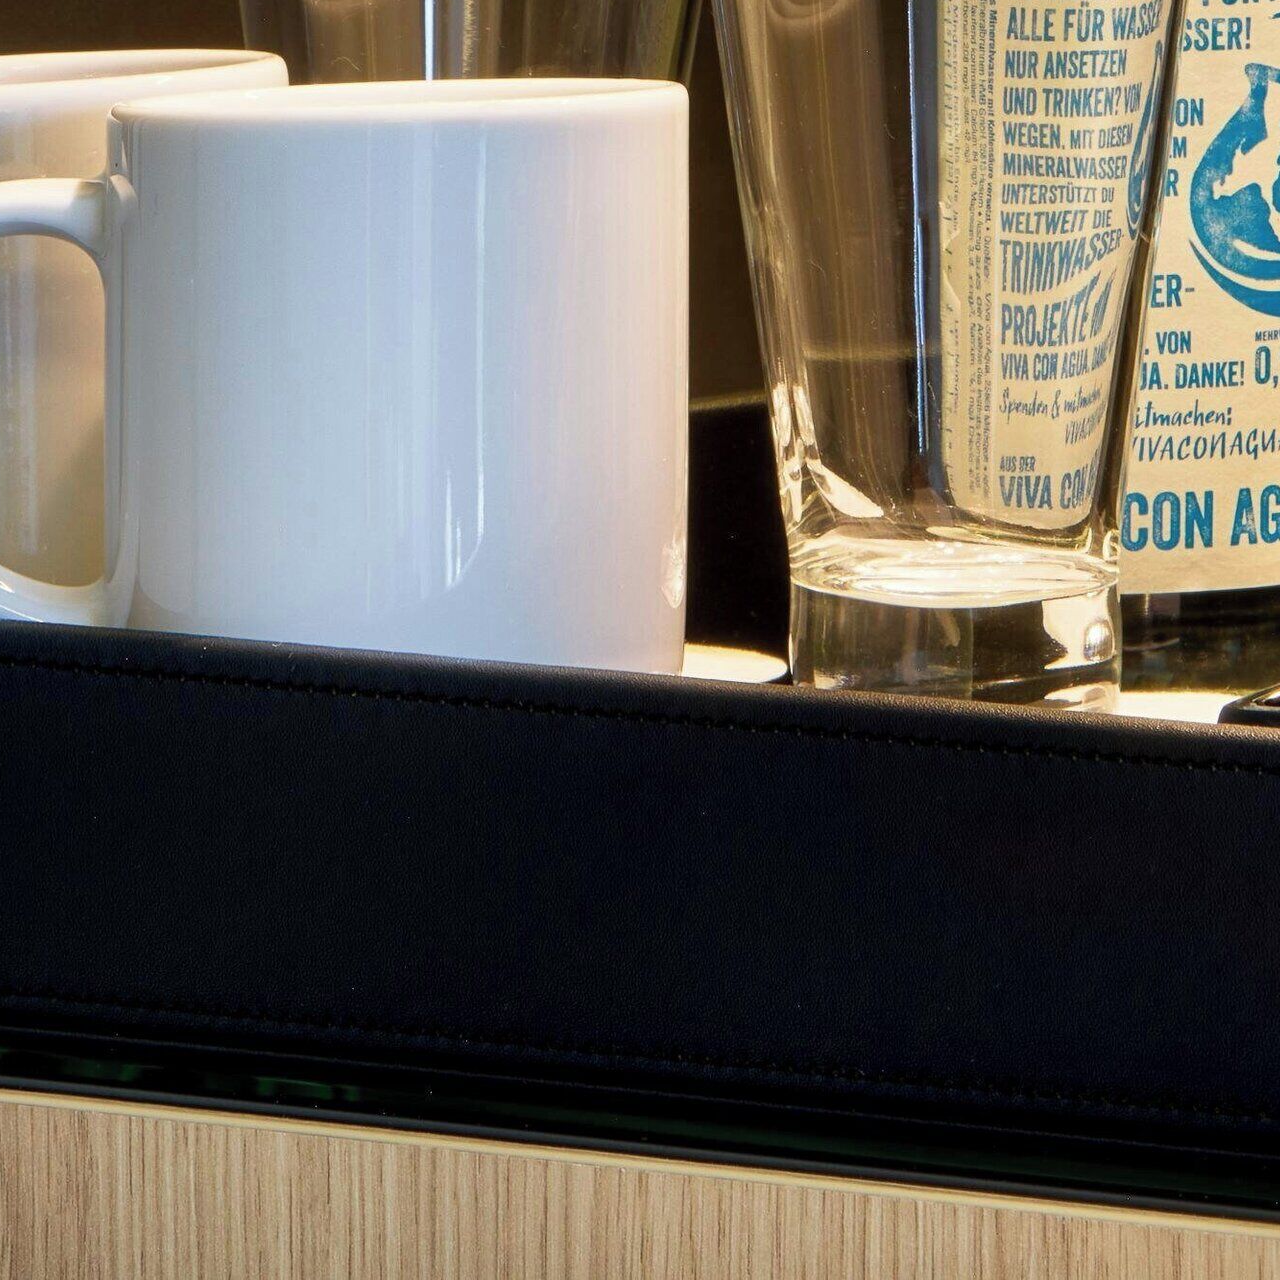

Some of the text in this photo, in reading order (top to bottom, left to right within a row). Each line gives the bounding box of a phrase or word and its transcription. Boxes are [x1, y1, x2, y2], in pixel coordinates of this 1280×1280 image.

[1007, 6, 1056, 42] ALLE
[1063, 0, 1106, 43] FÜR
[1005, 48, 1128, 80] NUR ANSETZEN
[1002, 86, 1038, 117] UND
[1042, 84, 1121, 118] TRINKEN?
[1003, 121, 1066, 151] WEGEN.
[1070, 128, 1095, 150] MIT
[1003, 152, 1128, 180] MINERALWASSER
[1001, 182, 1115, 205] UNTERSTÜTZT DU
[1000, 209, 1113, 236] WELTWEIT DIE
[1001, 269, 1102, 348] PROJEKTE
[1156, 331, 1192, 354] VON
[1001, 352, 1029, 381] VIVA
[1033, 352, 1059, 382] CON
[1176, 360, 1245, 390] DANKE!
[999, 387, 1049, 425] Spenden
[1051, 389, 1062, 420] &
[1000, 455, 1036, 472] AUS DER
[999, 474, 1053, 510] VIVA
[1120, 489, 1214, 552] CON
